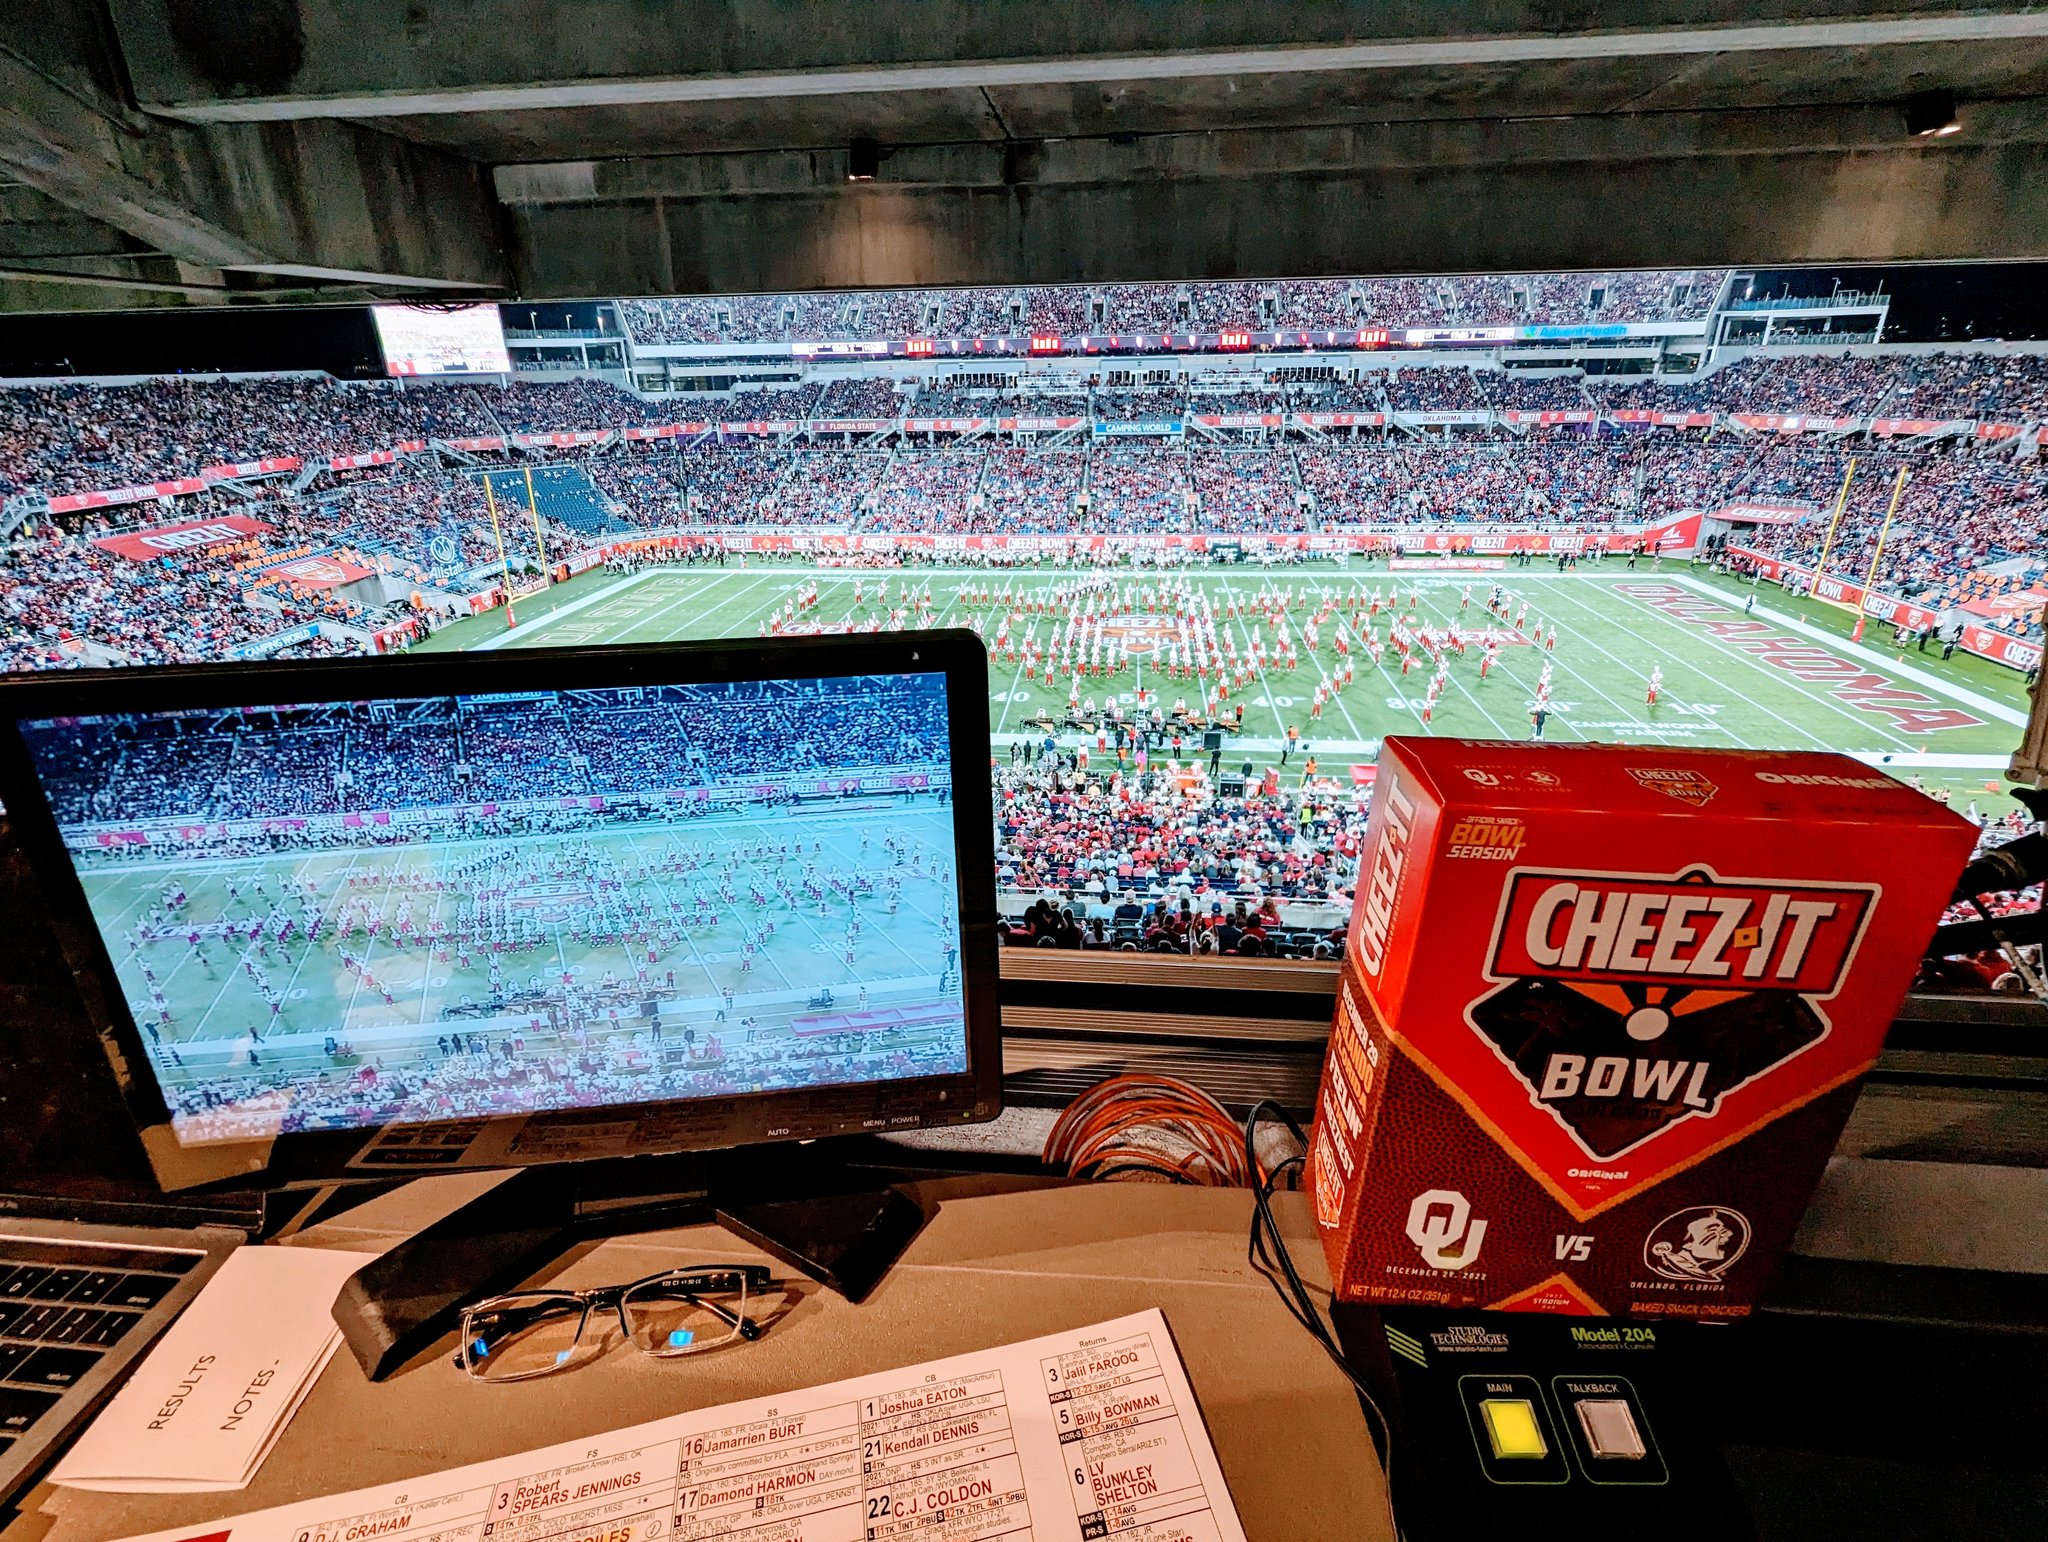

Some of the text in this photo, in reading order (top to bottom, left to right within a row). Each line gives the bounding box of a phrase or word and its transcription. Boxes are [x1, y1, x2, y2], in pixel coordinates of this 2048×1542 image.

[1541, 325, 1627, 337] AdventHealth
[1105, 422, 1172, 432] CAMPING WORLD
[1472, 537, 1506, 549] CHEEZ-IT
[1550, 537, 1584, 549] CHEEZ-IT
[428, 562, 464, 580] Allstate
[1818, 578, 1843, 600] BOWL
[244, 628, 311, 657] CAMPING WORLD
[1611, 583, 1990, 734] OKLAHOMA
[2004, 641, 2042, 667] CHEEZ
[506, 690, 542, 699] WORLD
[991, 691, 1030, 702] 40
[1251, 695, 1293, 708] 40
[1666, 702, 1719, 715] 10
[1612, 728, 1696, 738] STADIUM
[1652, 721, 1721, 731] WORLD
[1634, 770, 1697, 781] CHEEZ-IT
[1448, 823, 1527, 848] BOWL
[1446, 844, 1520, 861] SEASON
[1360, 774, 1414, 977] CHEEZ-IT
[1524, 882, 1842, 981] CHEEZ-IT
[1338, 999, 1374, 1093] ORLANDO
[1540, 1052, 1712, 1109] BOWL
[863, 1119, 886, 1127] MENU
[891, 1115, 920, 1124] POWER
[767, 1128, 790, 1136] AUTO
[1324, 1088, 1355, 1180] CHEEZIEST
[1405, 1189, 1488, 1270] OU
[1556, 1234, 1594, 1261] VS
[1386, 1265, 1438, 1277] DECEMBER
[1463, 1272, 1487, 1281] 2022
[1350, 1284, 1369, 1296] NET
[1371, 1286, 1387, 1297] WT
[1388, 1288, 1407, 1299] 12.4
[1408, 1289, 1422, 1300] OZ
[1683, 1282, 1726, 1292] FLORIDA
[1630, 1302, 1752, 1316] BAKED SNACK CRACKERS
[1430, 1333, 1509, 1346] TECHNOLOGIES
[1448, 1326, 1486, 1337] STUDIO
[1571, 1327, 1656, 1342] Model 204
[1079, 1336, 1107, 1348] Returns
[1064, 1364, 1087, 1380] Jalil
[1088, 1352, 1139, 1374] FAROOQ
[925, 1374, 937, 1383] CB
[1048, 1368, 1059, 1382] 3
[147, 1354, 216, 1430] RESULTS
[1486, 1383, 1513, 1393] MAIN
[1567, 1383, 1619, 1393] TALKBACK
[881, 1398, 924, 1416] Joshua
[926, 1386, 967, 1405] EATON
[1050, 1390, 1072, 1403] KOR-S
[767, 1408, 778, 1417] SS
[866, 1402, 873, 1417] 1
[1060, 1409, 1069, 1425] 5
[1076, 1394, 1160, 1427] Billy BOWMAN
[704, 1432, 765, 1453] Jamarrien
[769, 1422, 804, 1440] BURT
[885, 1434, 930, 1454] Kendall
[933, 1421, 979, 1443] DENNIS
[1060, 1430, 1081, 1443] KOR-S
[586, 1449, 598, 1459] FS
[684, 1438, 703, 1456] 16
[864, 1440, 881, 1458] 21
[1074, 1468, 1085, 1485] 6
[1089, 1461, 1104, 1477] LV
[1092, 1464, 1153, 1492] BUNKLEY
[512, 1489, 569, 1515] SPEARS
[572, 1471, 642, 1500] JENNINGS
[516, 1478, 561, 1500] Robert
[700, 1484, 754, 1506] Damond
[757, 1470, 816, 1495] HARMON
[1096, 1479, 1158, 1506] SHELTON
[395, 1495, 408, 1505] CB
[498, 1492, 509, 1510] 3
[679, 1490, 699, 1510] 17
[894, 1498, 923, 1517] C.J.
[927, 1479, 993, 1509] COLDON
[868, 1495, 891, 1519] 22
[1080, 1512, 1102, 1527] KOR-S
[345, 1515, 412, 1541] GRAHAM
[1085, 1524, 1104, 1539] PR-S
